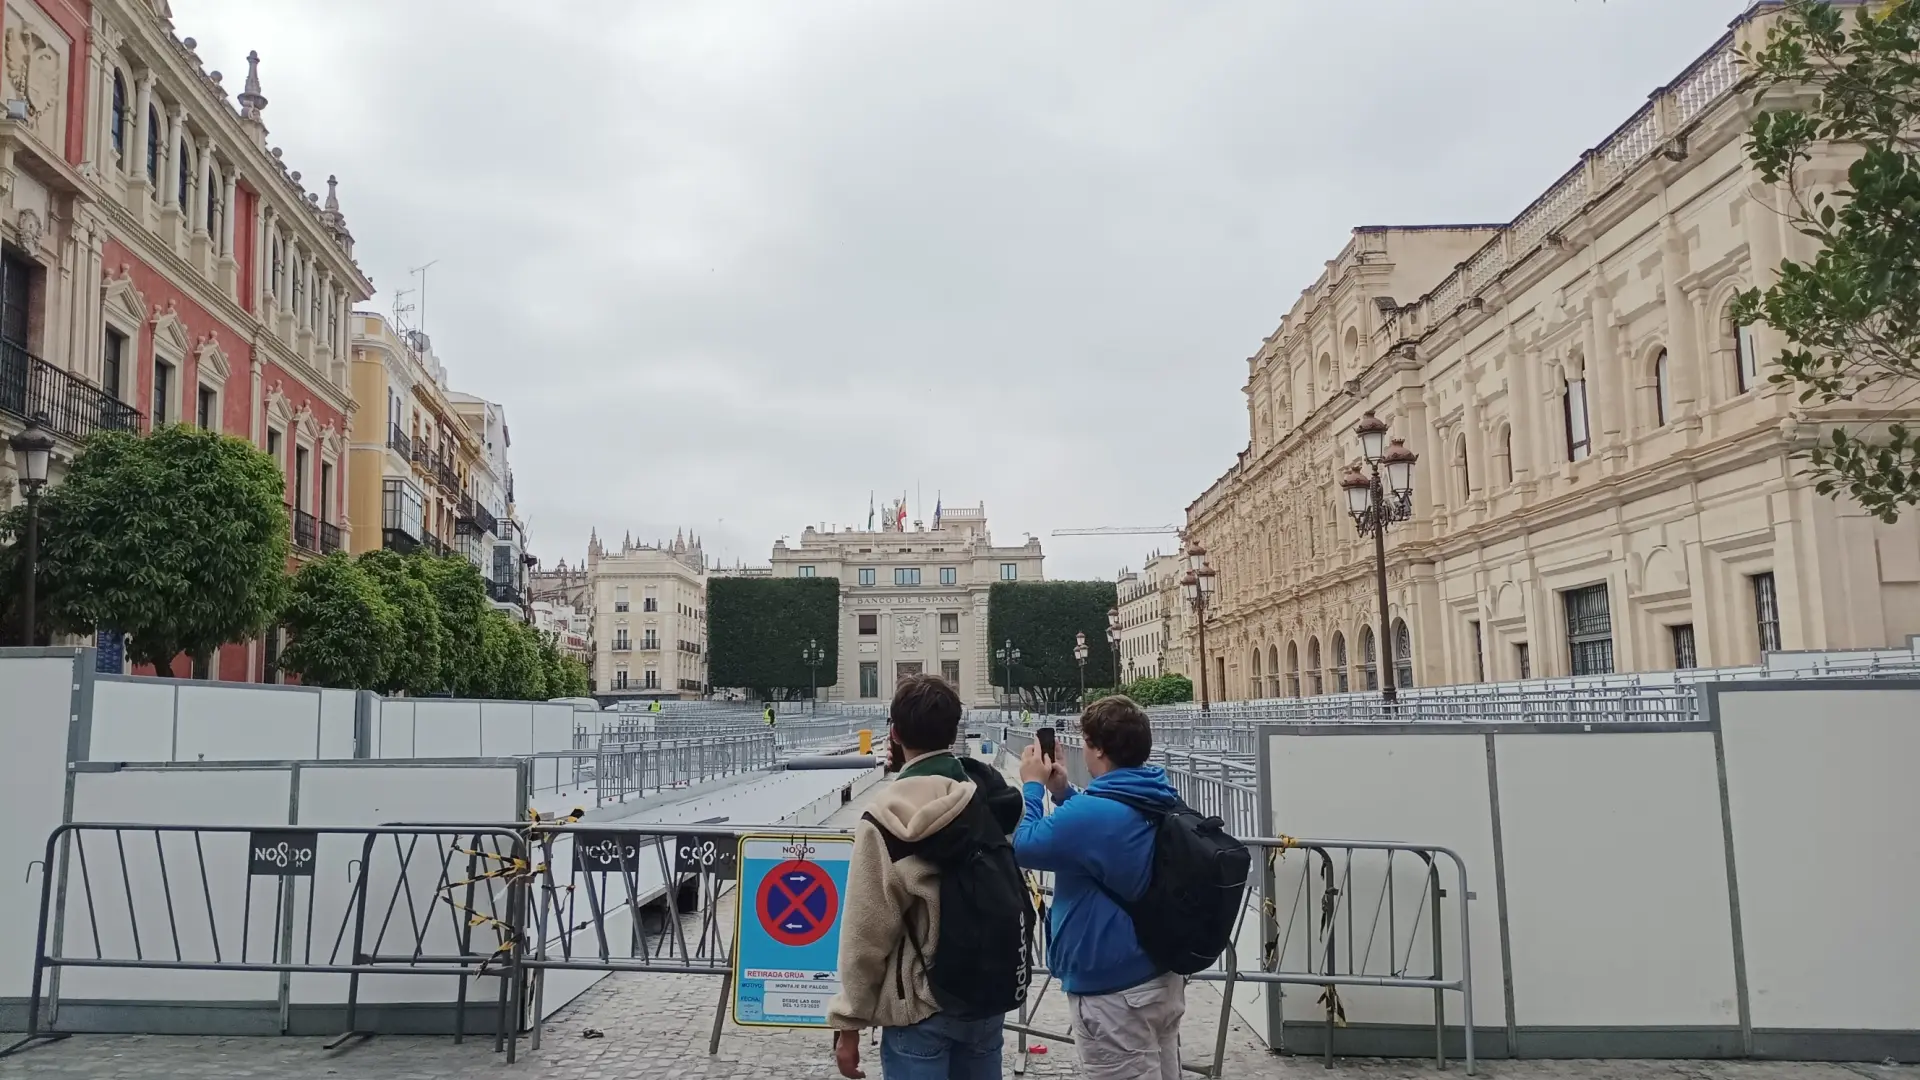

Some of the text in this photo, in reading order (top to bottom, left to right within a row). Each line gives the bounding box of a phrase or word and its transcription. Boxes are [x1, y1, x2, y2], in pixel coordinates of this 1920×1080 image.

[918, 595, 959, 603] ESPAÑA
[1014, 911, 1027, 1001] adidas
[747, 970, 783, 978] RETIRADA
